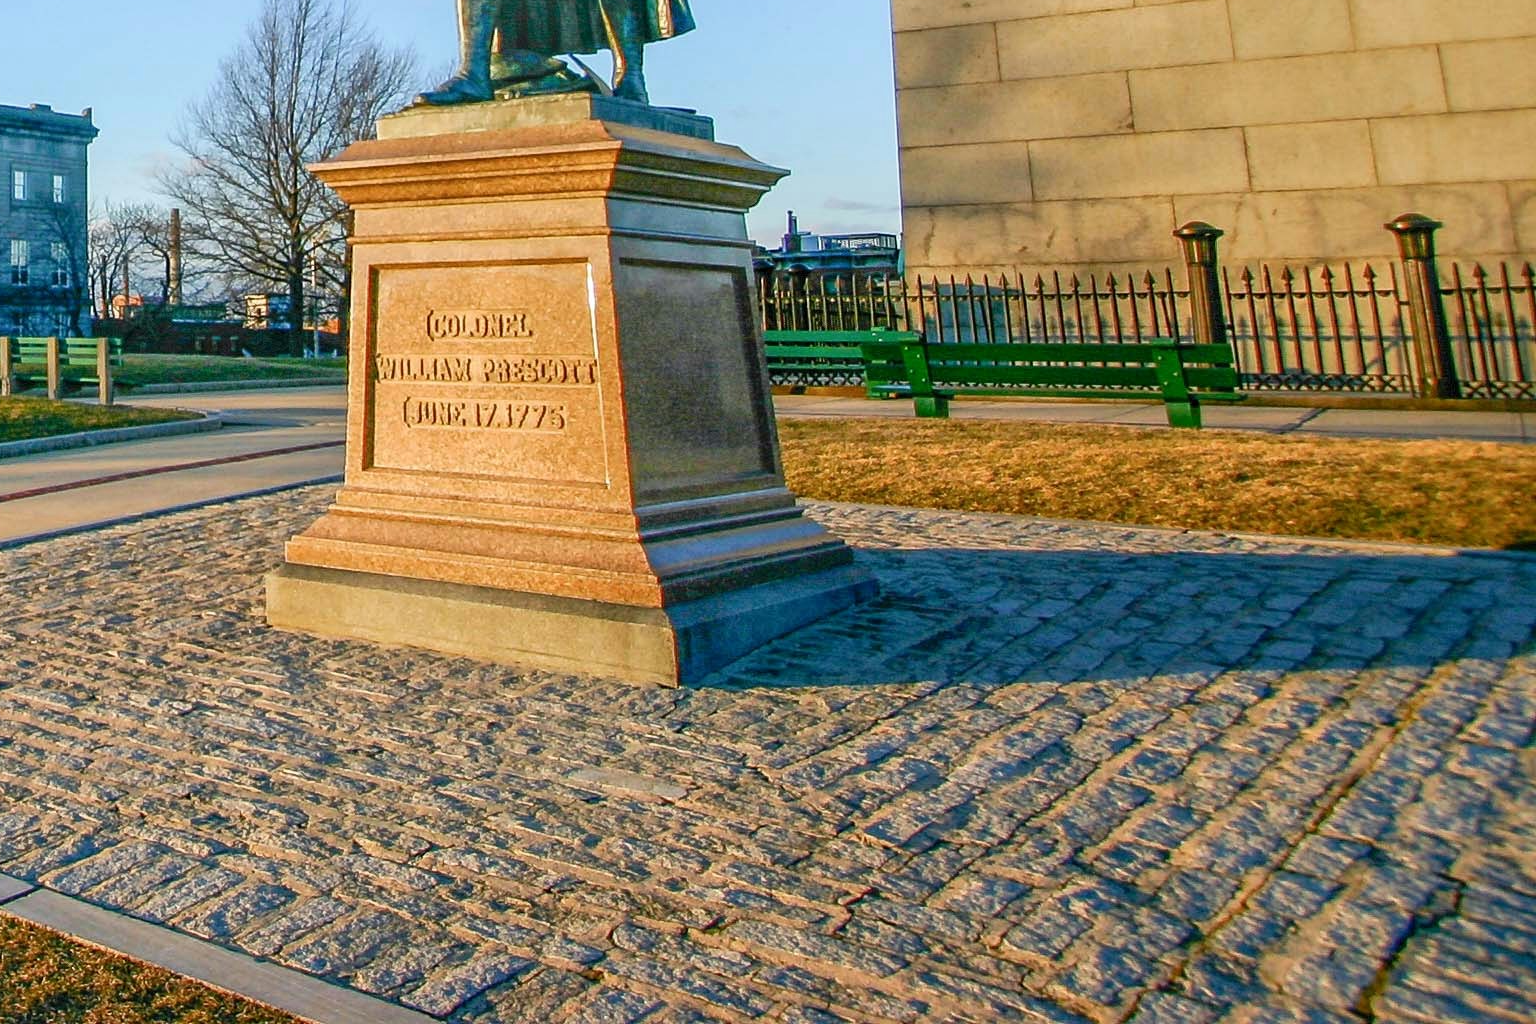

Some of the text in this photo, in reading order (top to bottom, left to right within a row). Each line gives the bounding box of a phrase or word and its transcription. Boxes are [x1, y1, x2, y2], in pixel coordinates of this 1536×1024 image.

[432, 313, 533, 337] COLONEL
[379, 358, 597, 383] WILLIAM PRESCOTT
